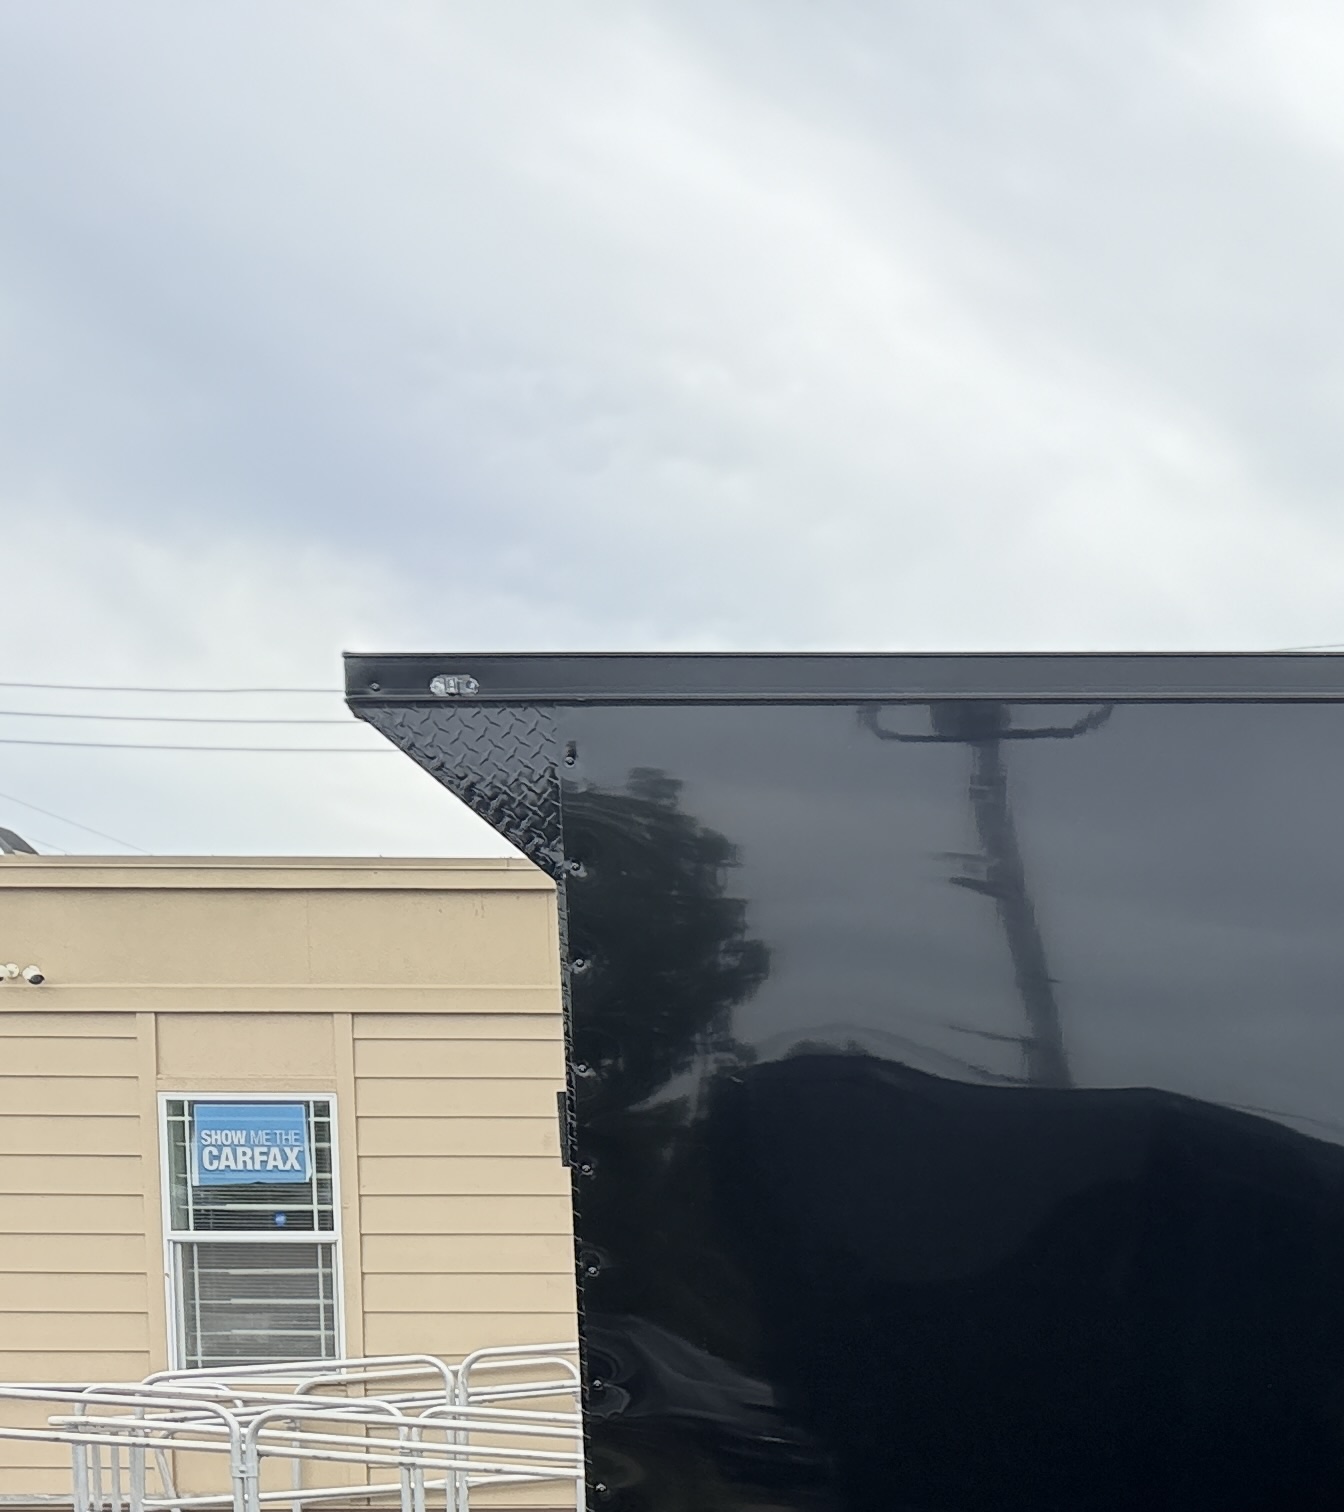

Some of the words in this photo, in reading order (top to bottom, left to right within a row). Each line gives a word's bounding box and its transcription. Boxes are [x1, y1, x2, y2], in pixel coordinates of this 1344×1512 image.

[200, 1129, 247, 1146] SHOW
[249, 1129, 273, 1146] ME
[273, 1129, 301, 1146] THE
[202, 1146, 304, 1171] CARFAX
